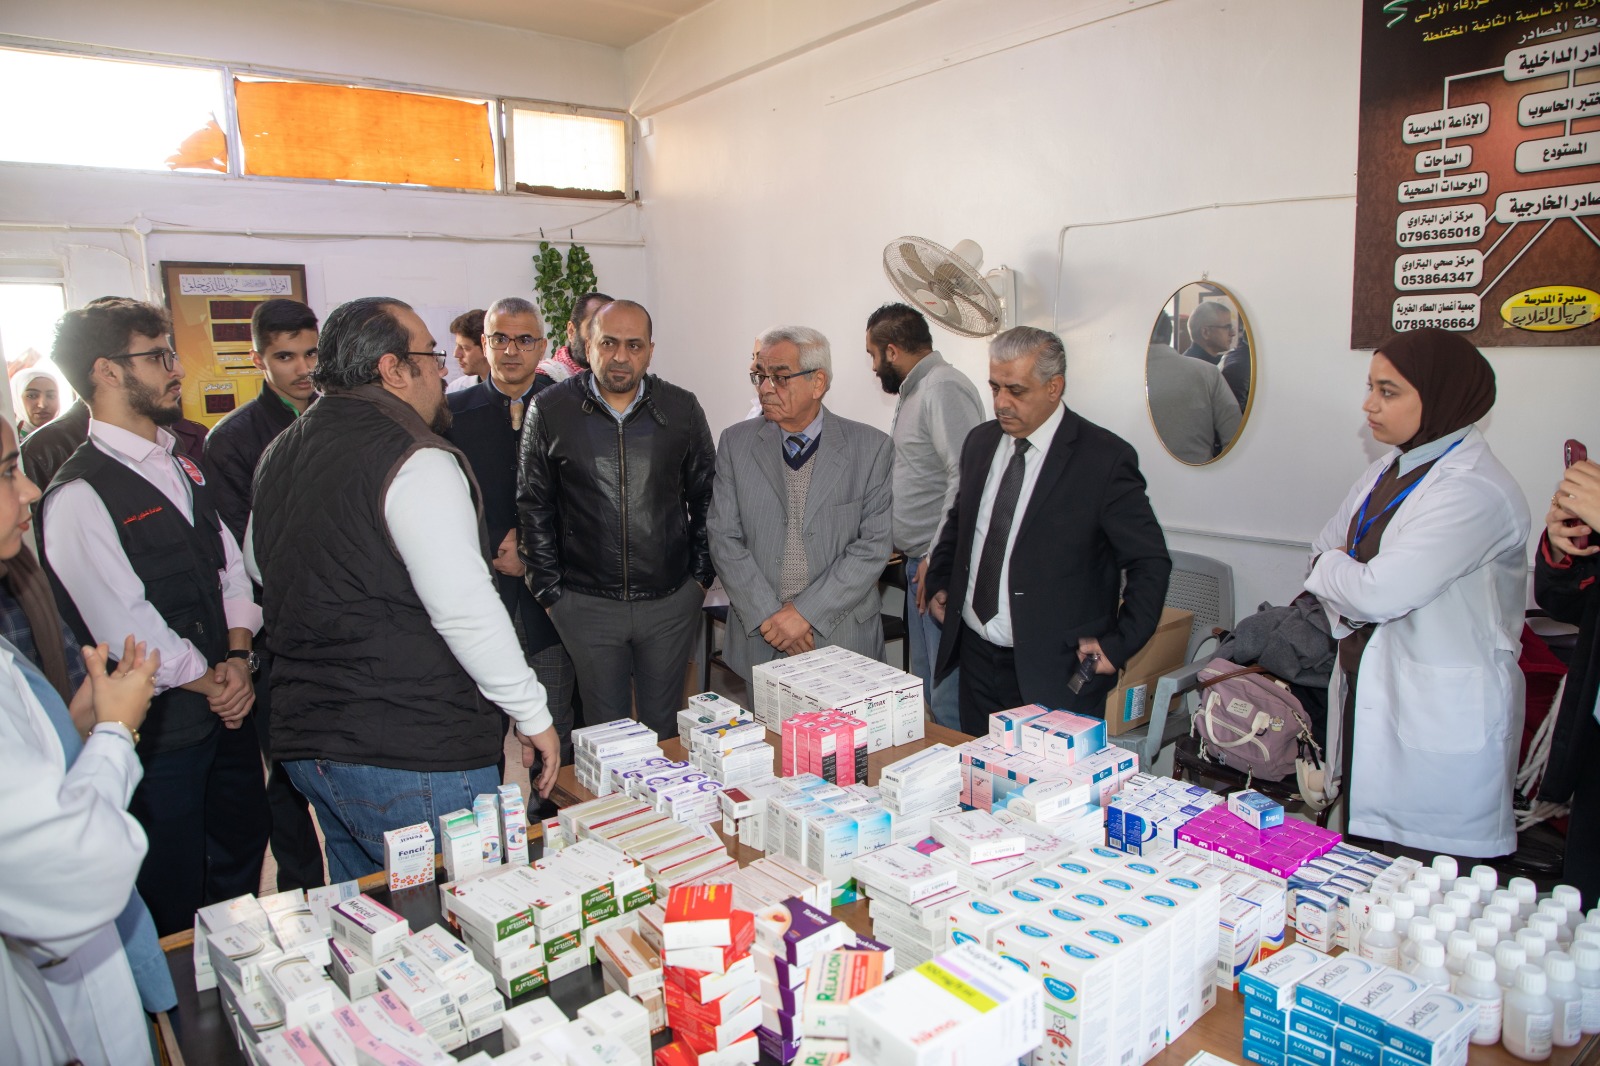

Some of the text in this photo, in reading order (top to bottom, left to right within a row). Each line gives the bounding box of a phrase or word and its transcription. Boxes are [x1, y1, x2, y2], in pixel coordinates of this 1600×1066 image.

[1414, 3, 1448, 23] الأولى
[1516, 1, 1568, 22] الأساسية
[1472, 14, 1511, 33] الثانية
[1517, 21, 1568, 44] المصادر
[1422, 25, 1468, 42] المختلطة
[1519, 46, 1578, 73] الداخلية
[1528, 98, 1574, 119] الحاسوب
[1408, 113, 1483, 137] الإذاعة المدرسية
[1424, 153, 1462, 168] الساحات
[1543, 142, 1587, 163] المستودع
[1403, 177, 1482, 199] الوحدات الصحية
[1509, 194, 1568, 217] الخارجية
[1407, 211, 1474, 228] مركز أمن البتراوي
[1399, 226, 1481, 242] 0796365018
[1401, 255, 1475, 272] مركز صحي البتراوي
[1401, 271, 1474, 285] 053864347
[1457, 301, 1476, 313] جمعية
[1524, 293, 1586, 305] مديرة المدرسة
[1395, 318, 1475, 330] 0789336664
[398, 846, 425, 857] Fencil
